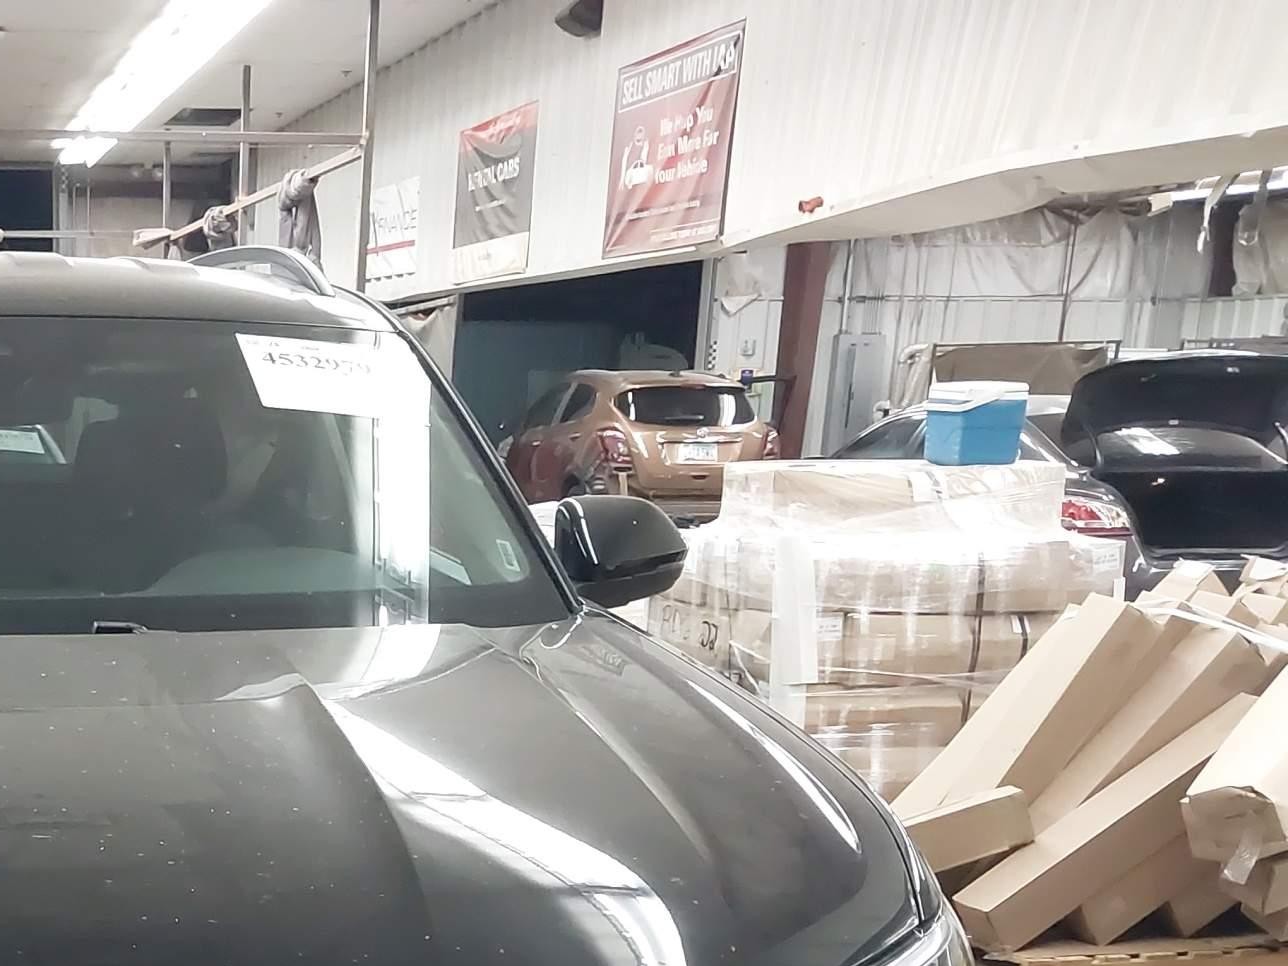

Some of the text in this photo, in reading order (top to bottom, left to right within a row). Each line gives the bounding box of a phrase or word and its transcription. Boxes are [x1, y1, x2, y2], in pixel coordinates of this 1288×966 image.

[622, 76, 645, 105] SELL
[645, 61, 682, 97] SMART
[682, 48, 713, 84] WITH
